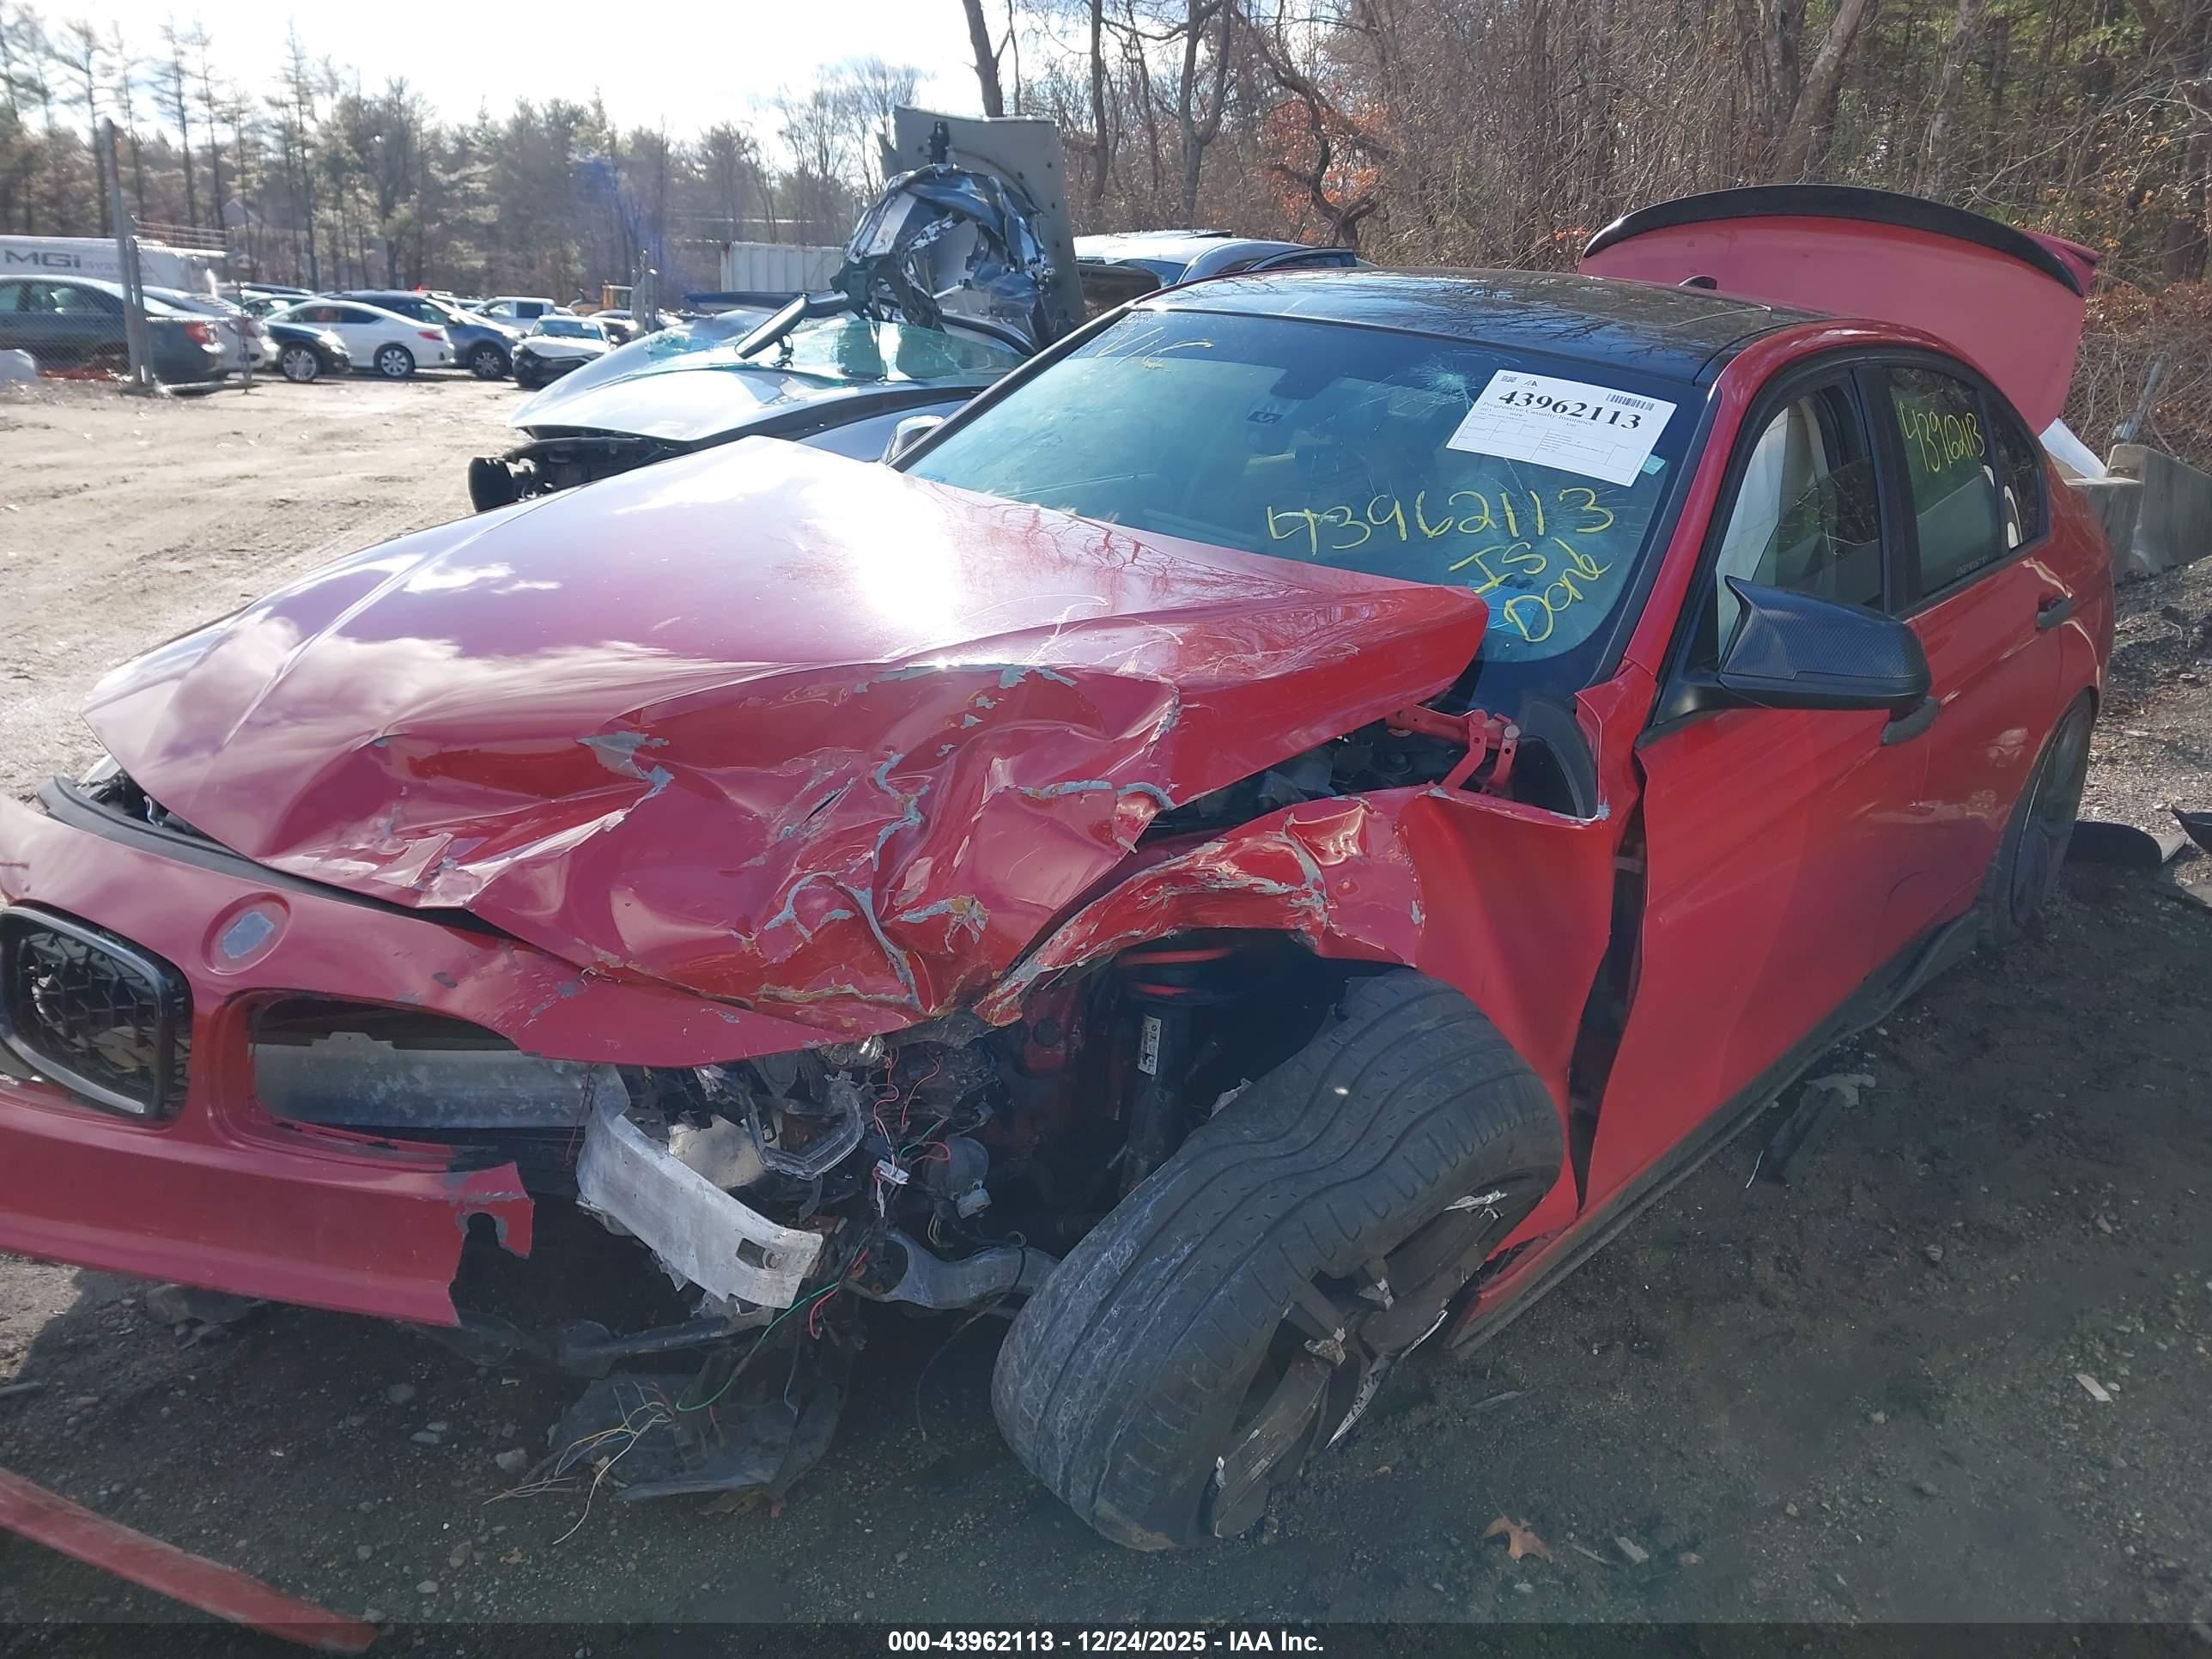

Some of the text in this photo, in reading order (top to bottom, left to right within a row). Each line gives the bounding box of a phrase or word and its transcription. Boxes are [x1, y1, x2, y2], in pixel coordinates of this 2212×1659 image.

[1482, 401, 1525, 413] Progressive
[1525, 408, 1558, 420] Casualty
[1559, 414, 1595, 426] Insurance
[1498, 390, 1642, 429] 43962113
[1899, 399, 1986, 473] 43962113
[1266, 487, 1614, 556] 43962113
